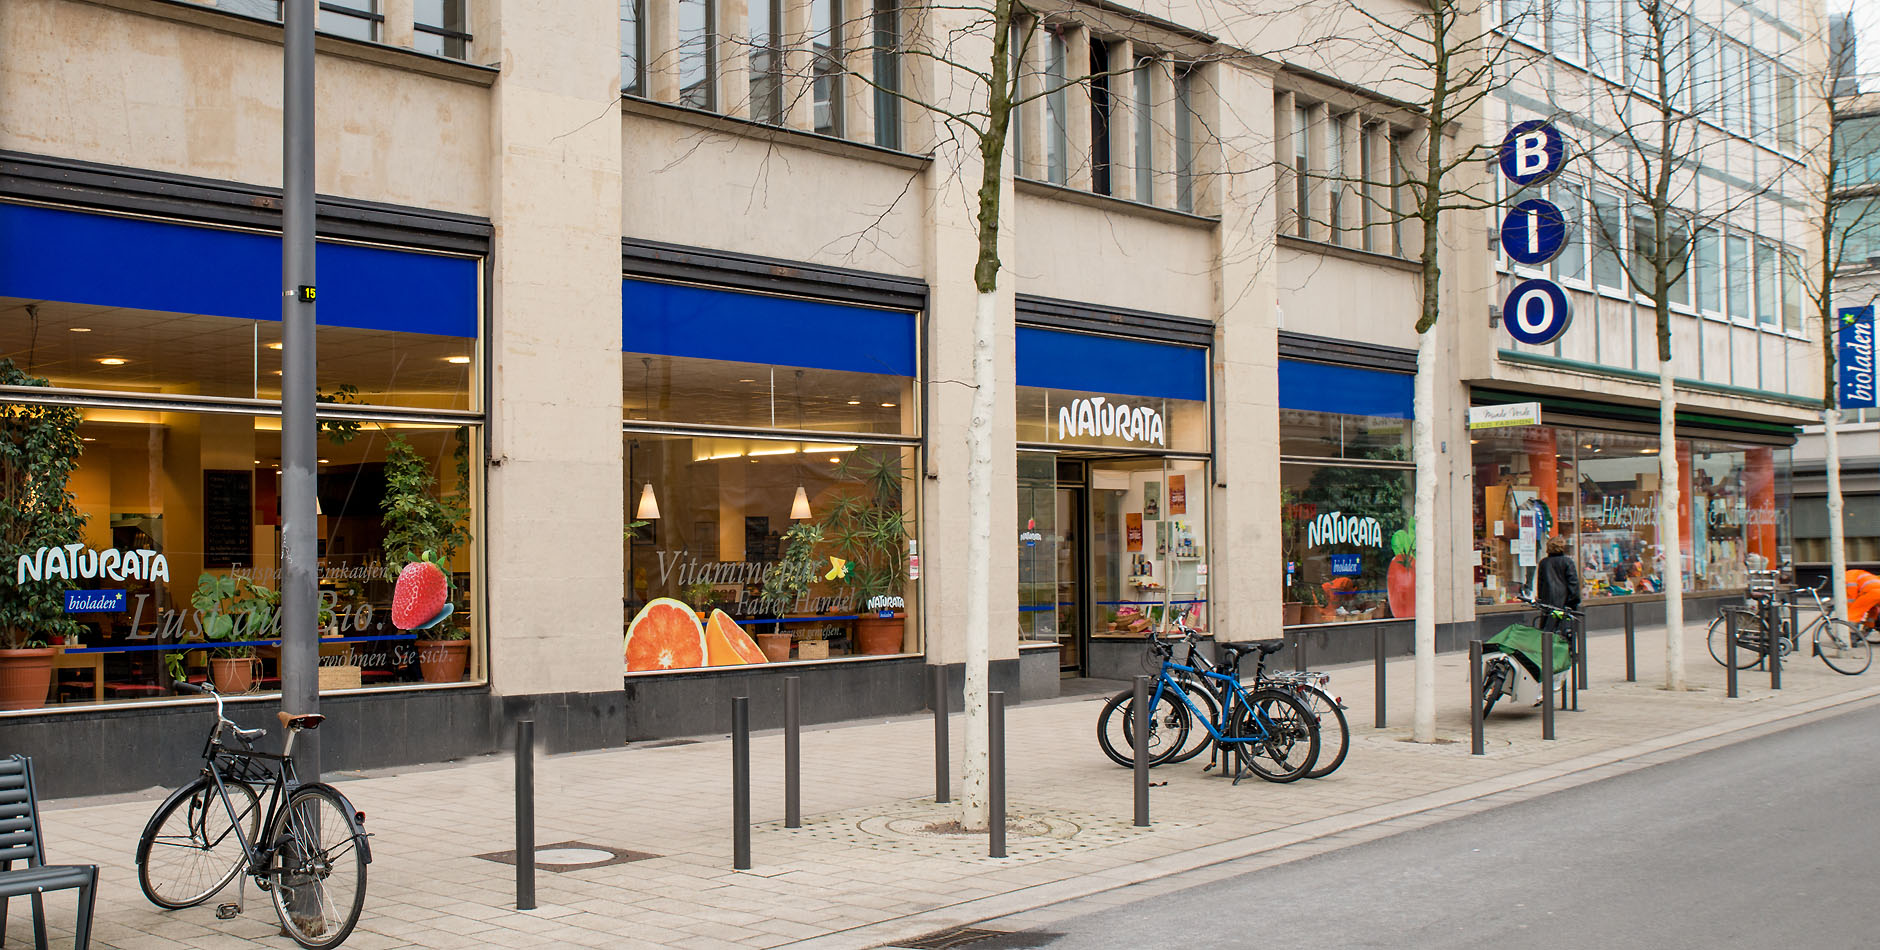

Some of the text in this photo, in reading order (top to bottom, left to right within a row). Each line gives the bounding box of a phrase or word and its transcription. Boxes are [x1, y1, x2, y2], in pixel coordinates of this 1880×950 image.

[305, 287, 316, 299] 15
[1846, 322, 1873, 401] bioladen
[1059, 396, 1164, 446] NATURATA
[1308, 511, 1383, 549] NATURATA
[17, 543, 170, 585] NATURATA
[230, 562, 282, 584] Entspa
[656, 550, 773, 587] Vitamine
[68, 596, 118, 612] bioladen
[232, 603, 282, 648] au
[318, 588, 383, 633] Bio.
[735, 586, 856, 617] Fairer Handel
[867, 596, 904, 610] NATURATA
[392, 645, 416, 665] Sie
